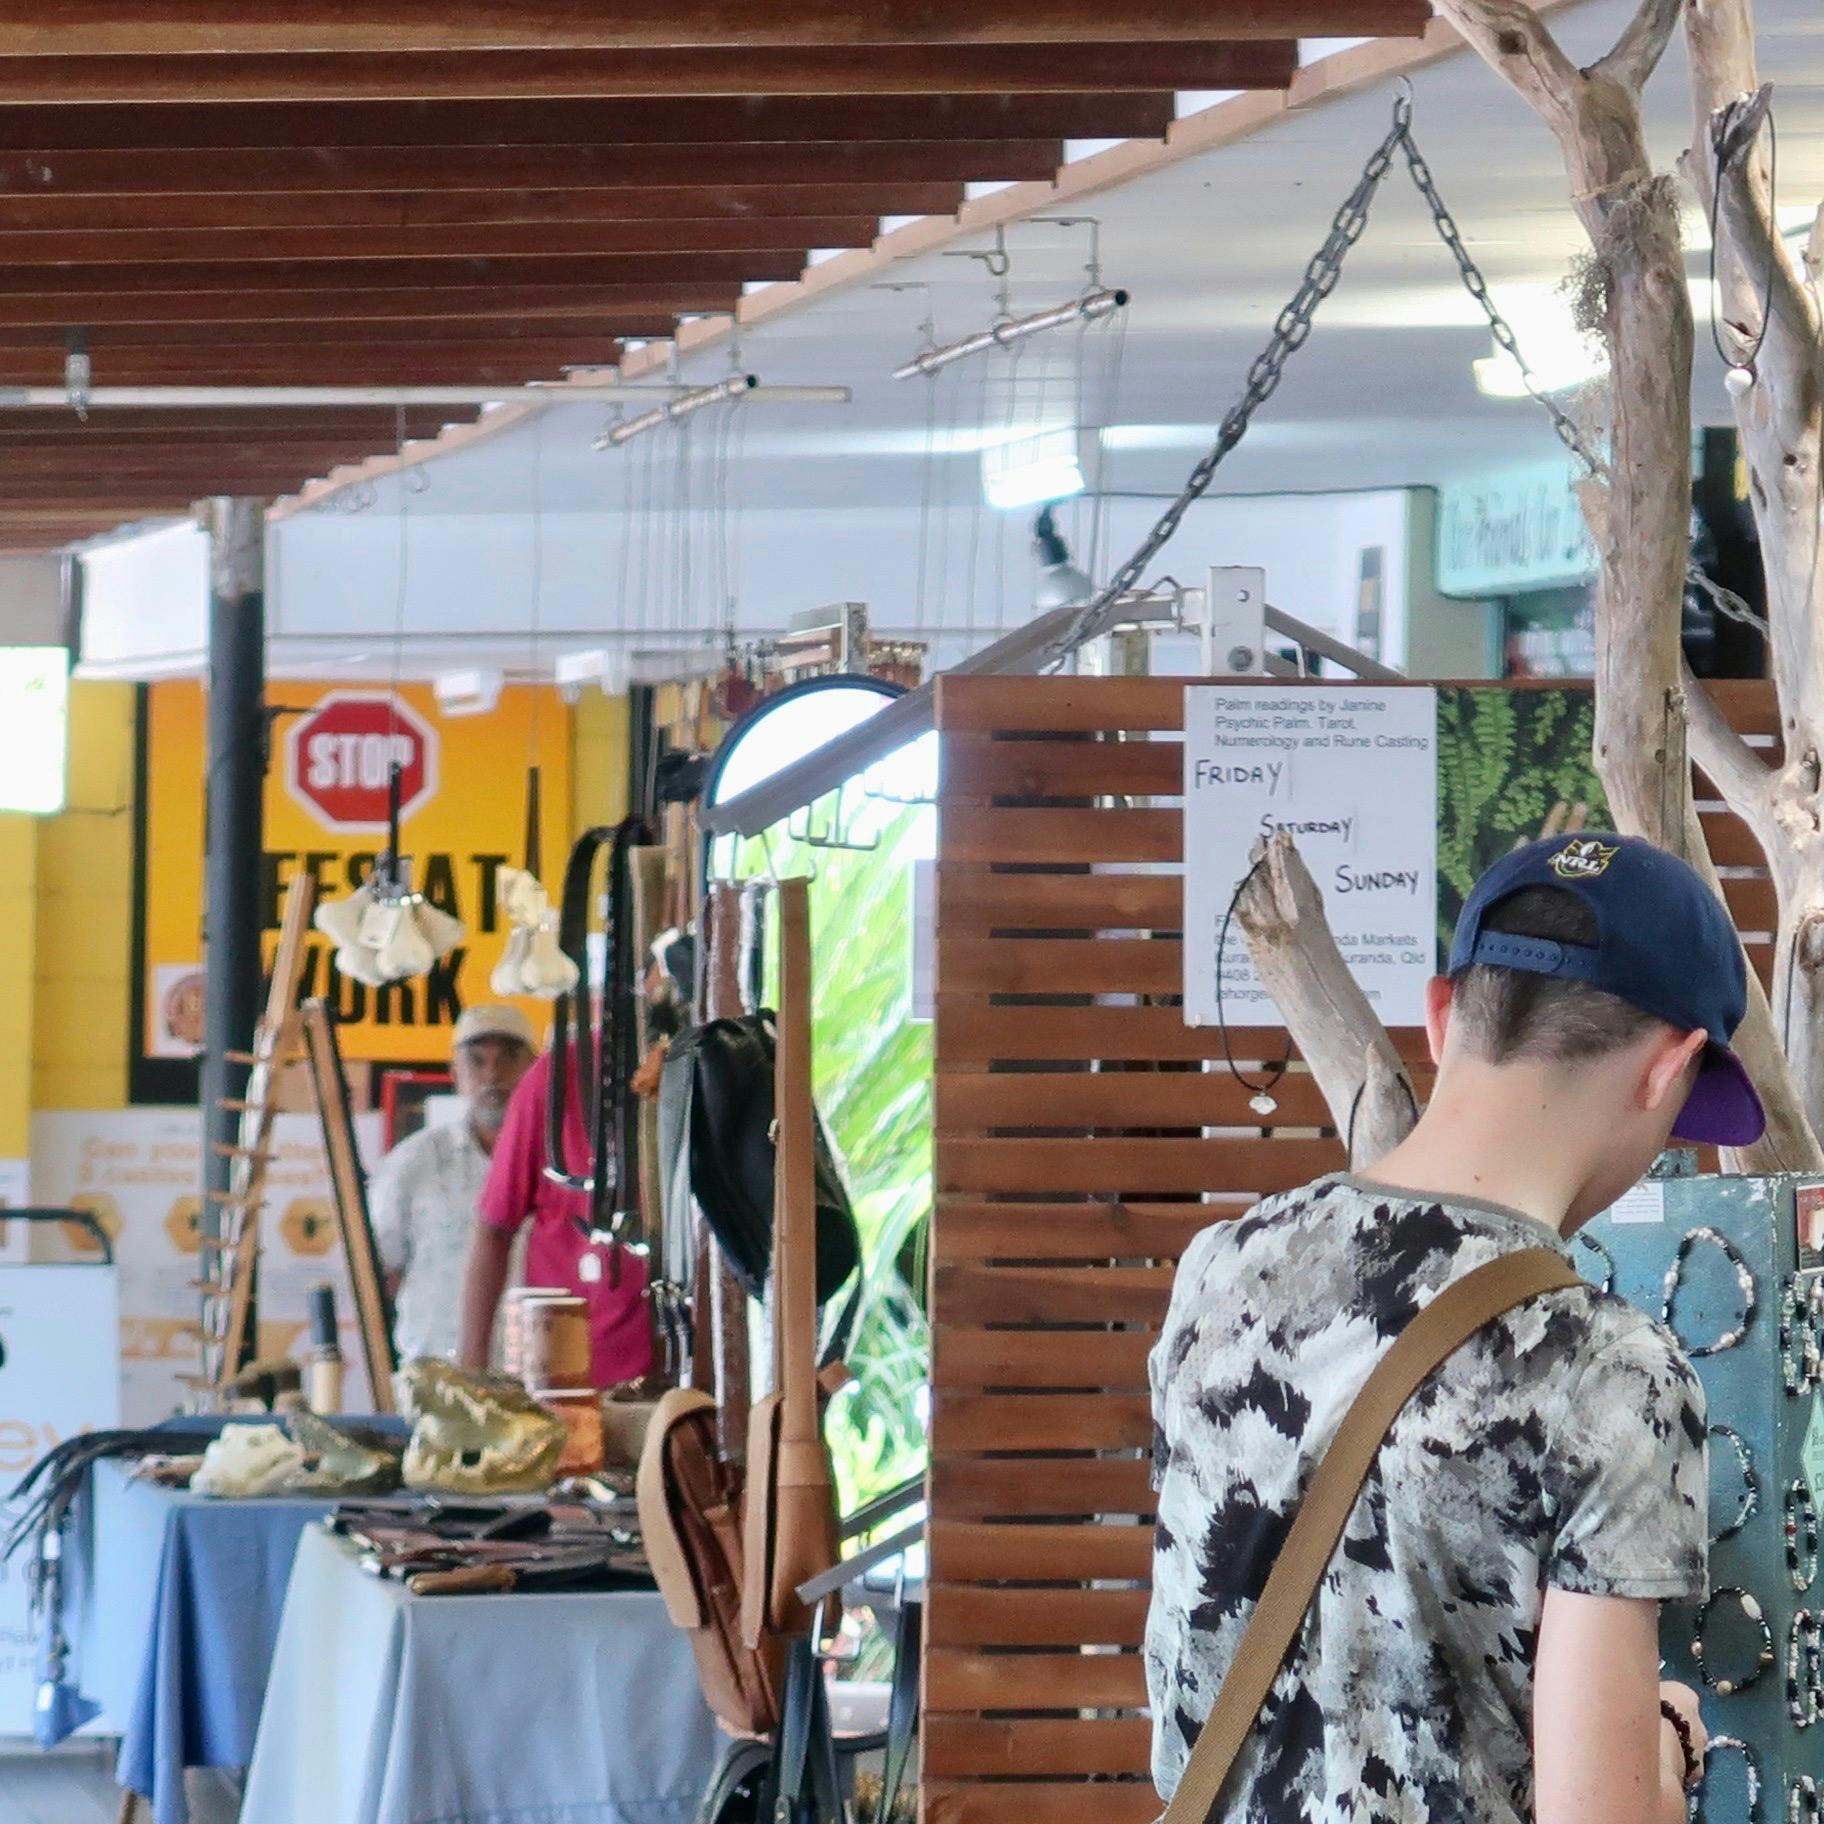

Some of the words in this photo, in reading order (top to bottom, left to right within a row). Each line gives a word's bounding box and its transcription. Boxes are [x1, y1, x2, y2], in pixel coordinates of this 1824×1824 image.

[1215, 698, 1251, 711] Palm
[1254, 698, 1315, 714] readings
[1318, 698, 1336, 714] by
[1215, 716, 1268, 731] Psychic
[1215, 735, 1299, 750] Numerology
[1303, 734, 1329, 747] and
[1333, 734, 1371, 748] Rune
[1375, 734, 1429, 750] Casting
[307, 732, 415, 789] STOP
[1194, 759, 1283, 797] FRIDAY
[1260, 813, 1353, 843] SATURDAY
[1335, 864, 1420, 895] SUNDAY
[1361, 933, 1419, 946] Markets
